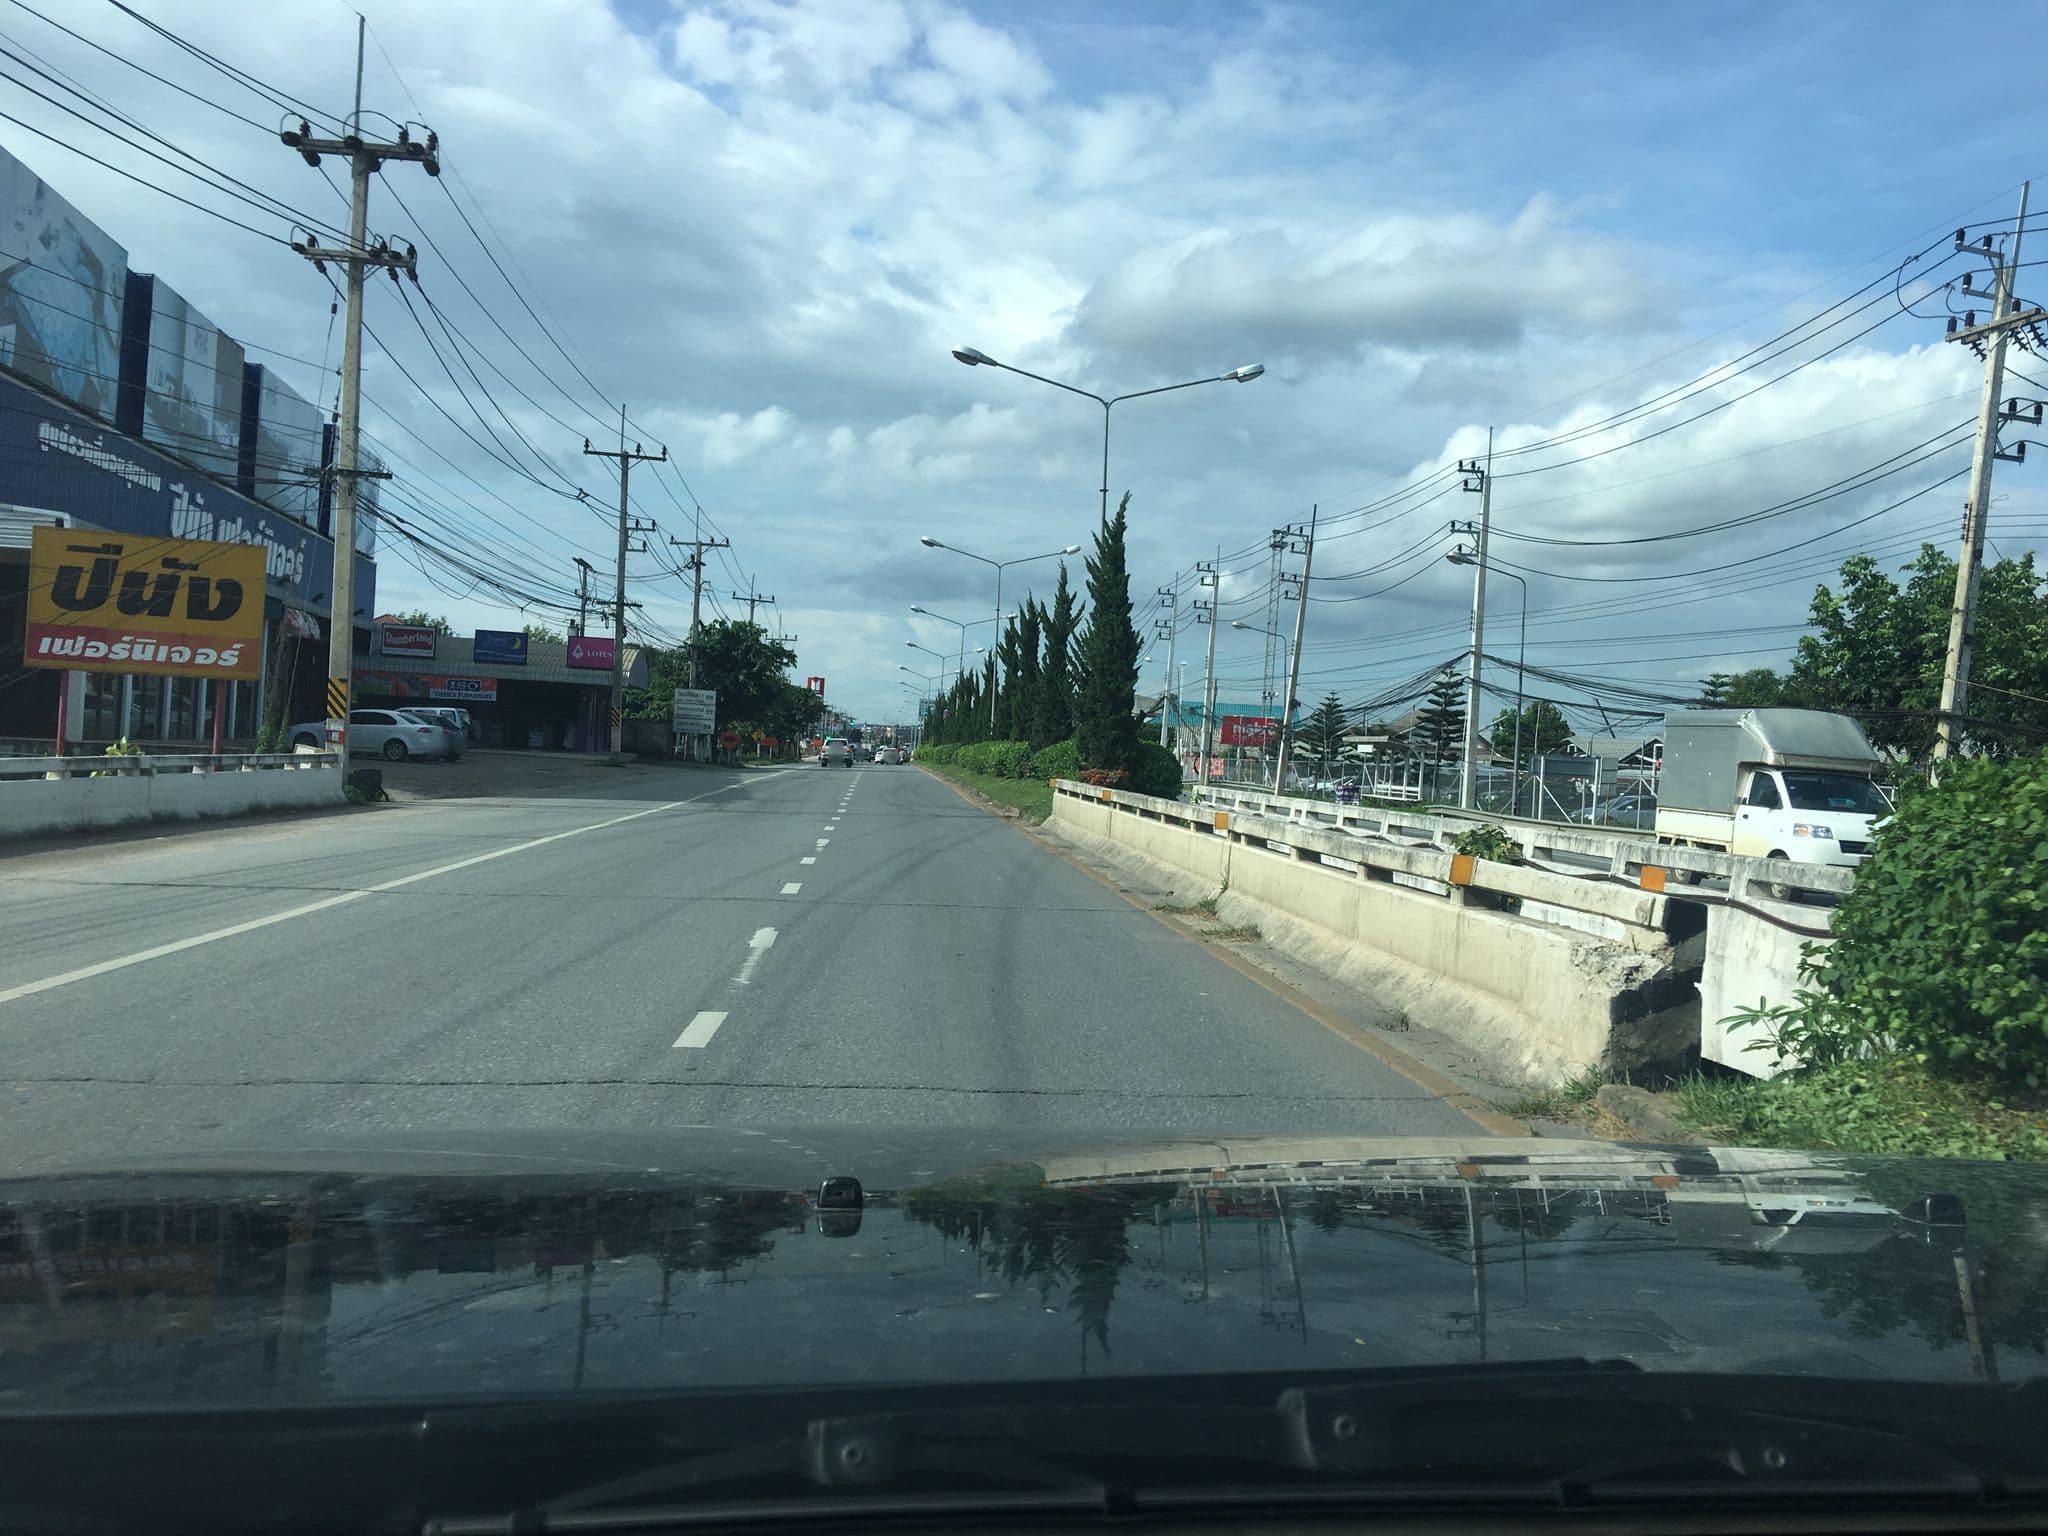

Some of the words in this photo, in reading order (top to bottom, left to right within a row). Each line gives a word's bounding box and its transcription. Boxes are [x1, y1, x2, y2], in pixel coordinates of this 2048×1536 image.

[51, 543, 244, 621] ปีนัง
[385, 631, 433, 645] Slumberland
[38, 635, 245, 668] เฟอร์นิเจอร์
[449, 681, 479, 690] ISO
